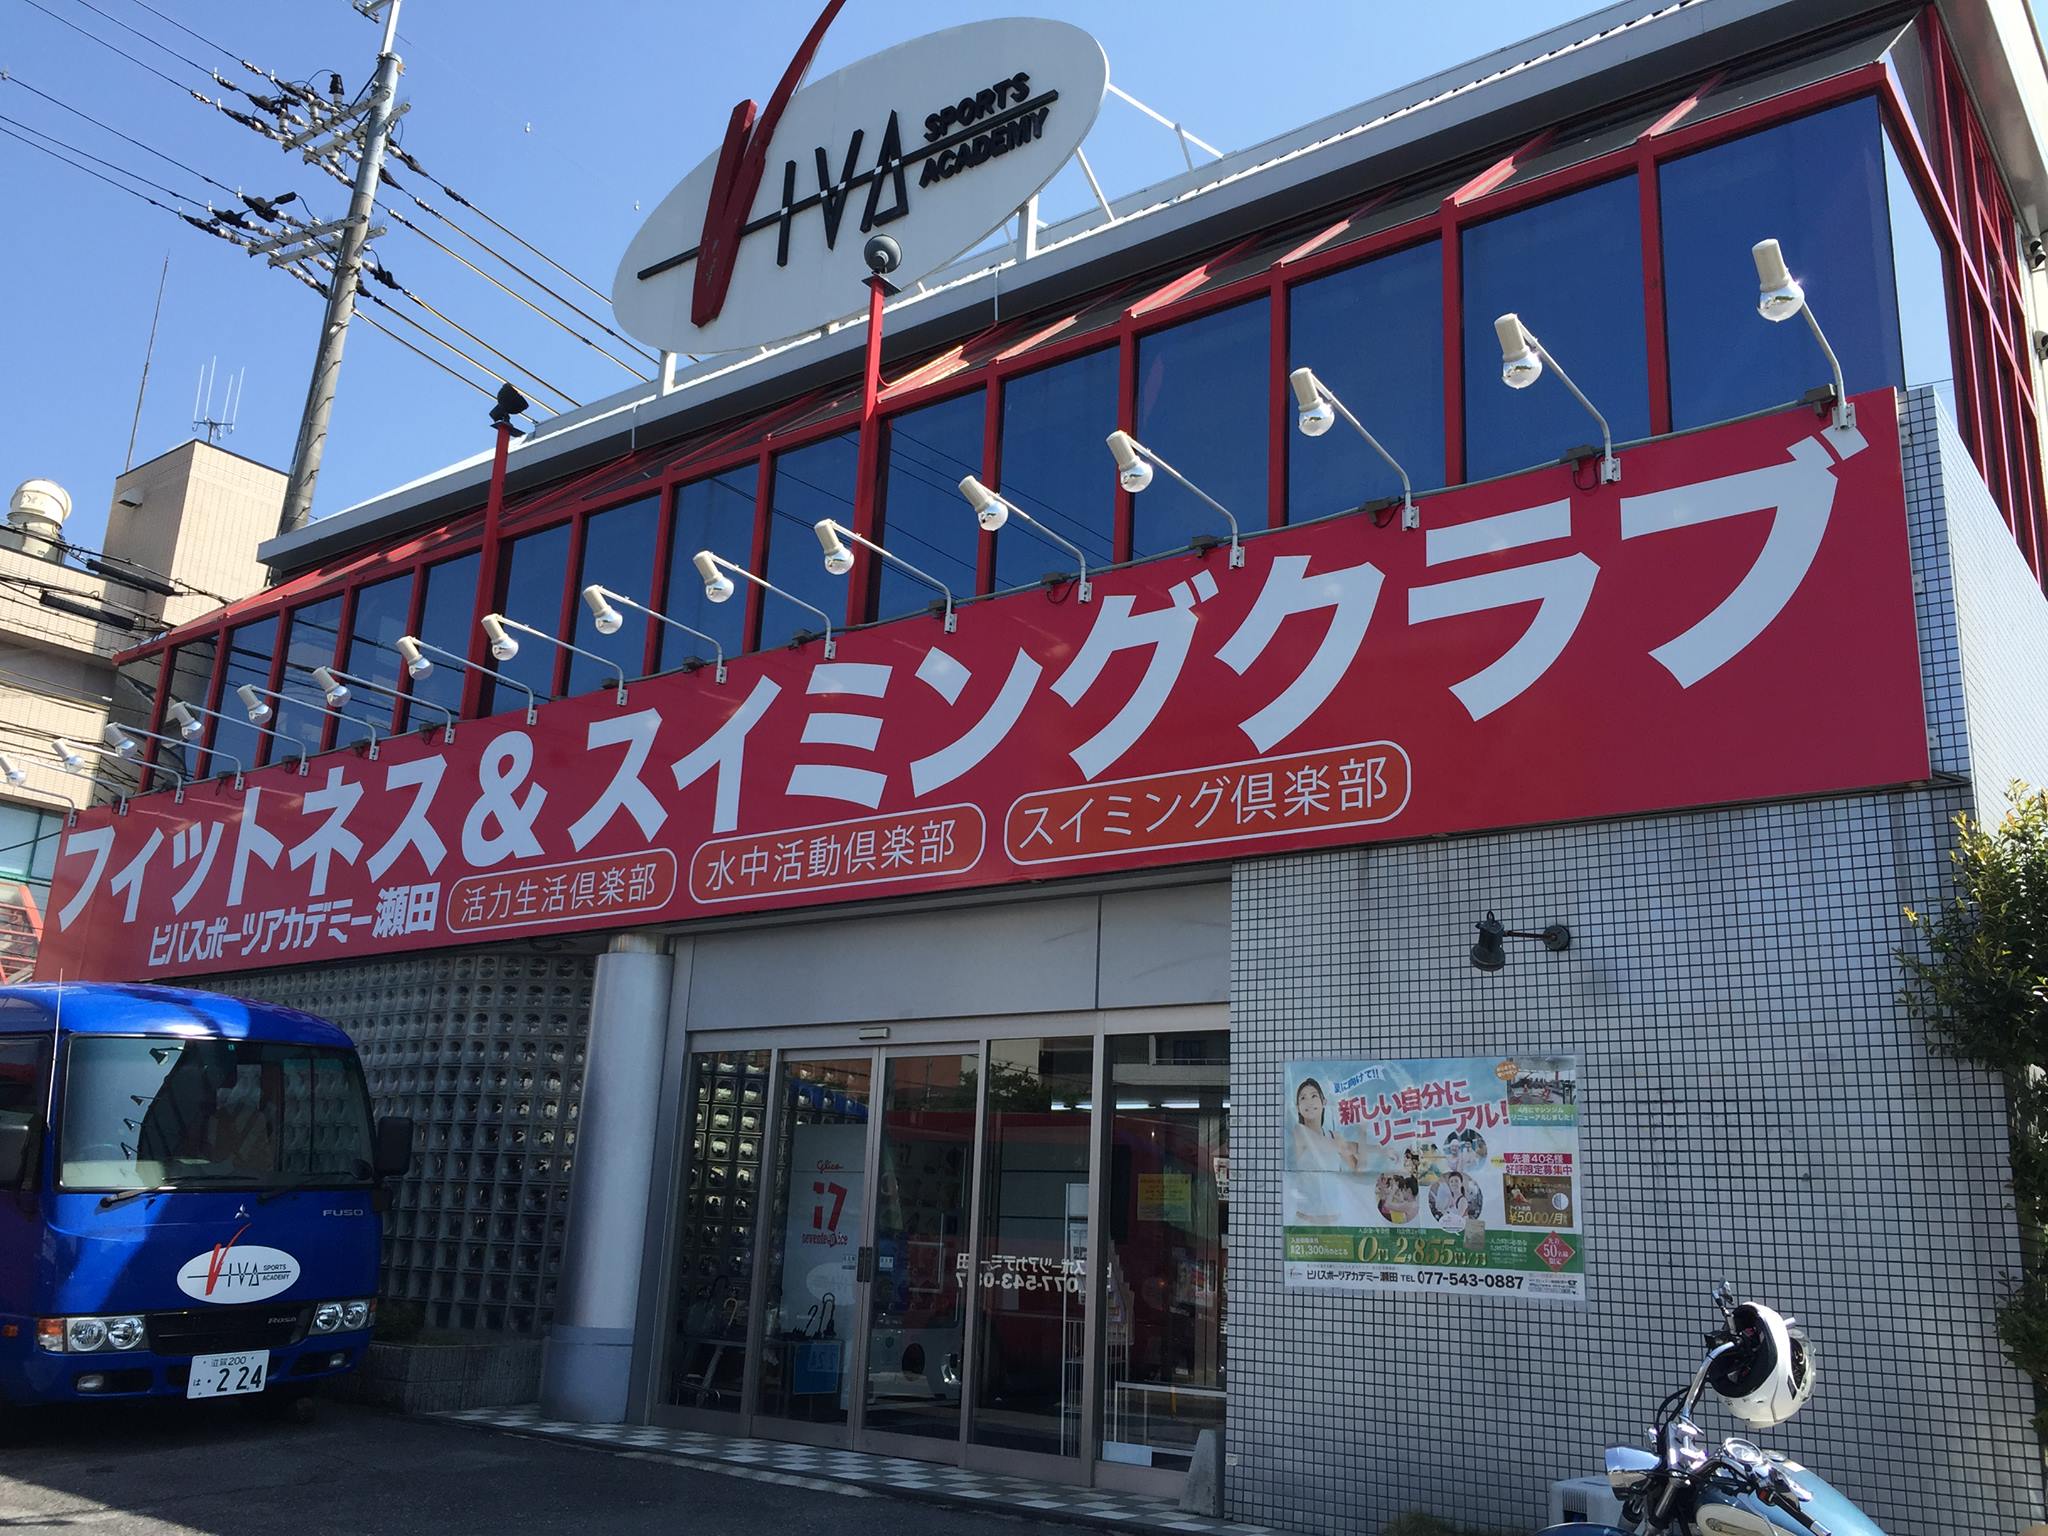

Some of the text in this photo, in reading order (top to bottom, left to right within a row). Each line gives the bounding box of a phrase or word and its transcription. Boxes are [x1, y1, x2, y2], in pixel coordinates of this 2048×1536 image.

[923, 72, 1031, 142] SPORTS
[919, 108, 1050, 188] ACADEMY
[1019, 757, 1387, 849] スイミング倶楽部
[705, 818, 956, 892] 水中活動倶楽部
[460, 862, 657, 923] 活力生活倶楽部
[1338, 1080, 1471, 1126] 新しい自分に
[1373, 1100, 1510, 1146] リニューアル!
[1513, 1153, 1563, 1164] 先着40名様
[205, 1222, 260, 1296] VIVA
[1401, 1274, 1416, 1283] TEL
[1417, 1271, 1524, 1289] 077-543-0887
